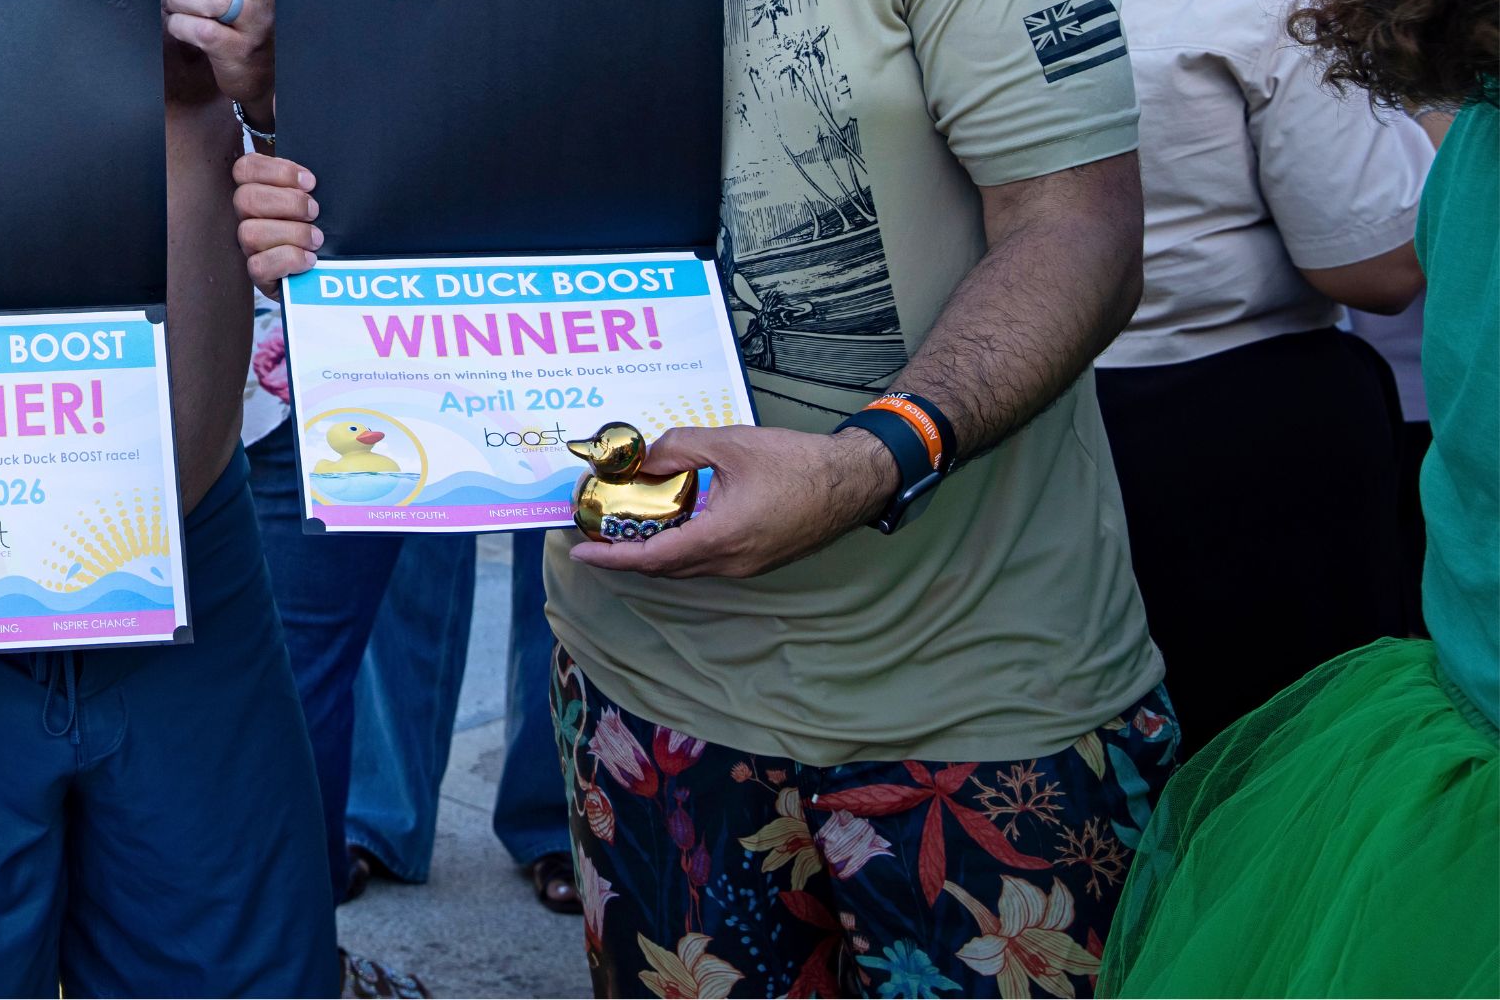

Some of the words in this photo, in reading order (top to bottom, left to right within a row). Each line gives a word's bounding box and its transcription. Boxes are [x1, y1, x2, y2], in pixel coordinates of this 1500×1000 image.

[319, 273, 425, 298] DUCK
[437, 272, 543, 297] DUCK
[553, 267, 675, 295] BOOST
[362, 306, 663, 358] WINNER!
[10, 330, 126, 364] BOOST
[322, 370, 429, 382] Congratulations
[434, 372, 450, 380] on
[455, 370, 507, 381] winning
[511, 369, 533, 378] the
[537, 368, 572, 378] Duck
[577, 366, 613, 376] Duck
[617, 363, 662, 374] BOOST
[666, 360, 703, 371] race!
[439, 390, 515, 417] April
[525, 386, 604, 411] 2026
[887, 399, 904, 408] for
[904, 404, 938, 440] Alliance
[484, 422, 567, 447] boost
[23, 452, 56, 465] Duck
[61, 451, 102, 463] BOOST
[106, 449, 140, 461] race!
[514, 446, 567, 454] CONFERENC
[368, 511, 407, 520] INSPIRE
[408, 511, 449, 520] YOUTH.
[489, 508, 529, 517] INSPIRE
[531, 506, 571, 516] LEARNI
[53, 620, 89, 631] INSPIRE
[91, 617, 139, 629] CHANGE.
